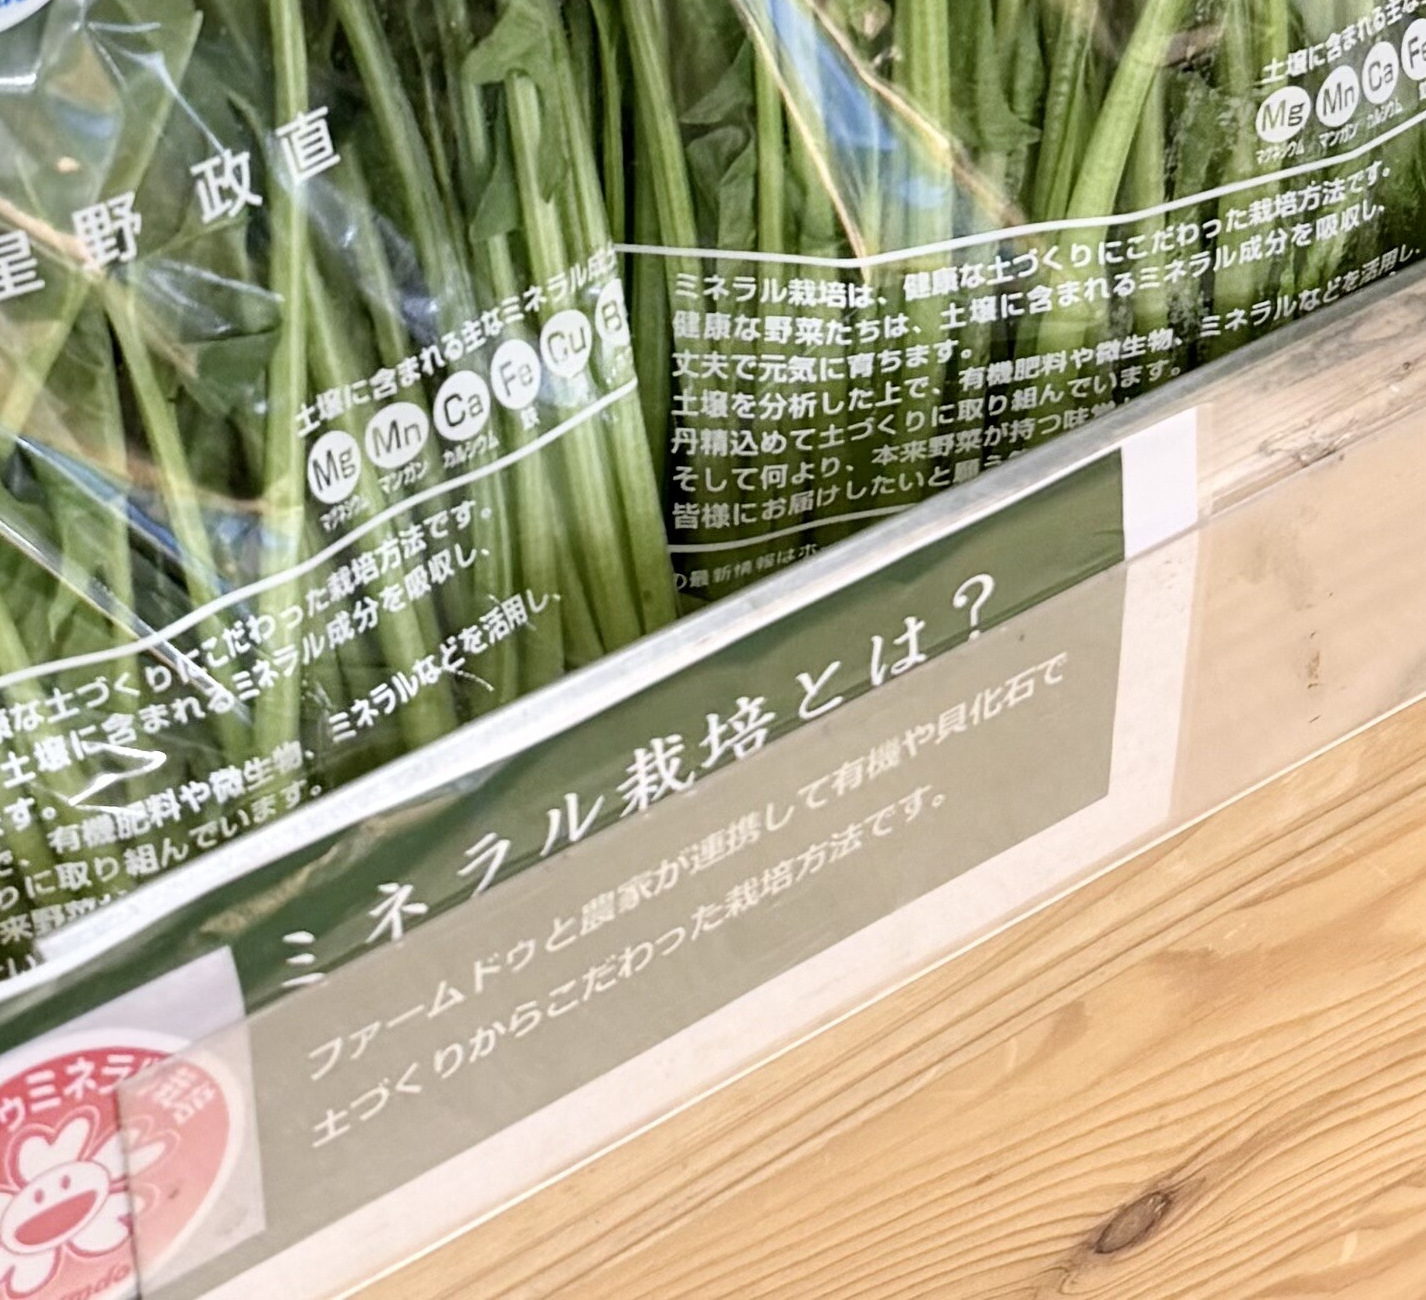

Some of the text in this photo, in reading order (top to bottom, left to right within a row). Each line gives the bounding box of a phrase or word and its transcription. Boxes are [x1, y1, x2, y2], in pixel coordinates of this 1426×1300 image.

[674, 161, 1391, 309] ミネラル栽培は、健康な土づくりにこだわった栽培方法です。
[670, 359, 1182, 458] 丹精込めて土づくりに取り組んでいます。
[671, 338, 973, 384] 丈夫で元気に育ちます。
[281, 573, 995, 989] ミネラル栽培とは？
[311, 784, 947, 1148] 土づくりからこだわった栽培方法です。
